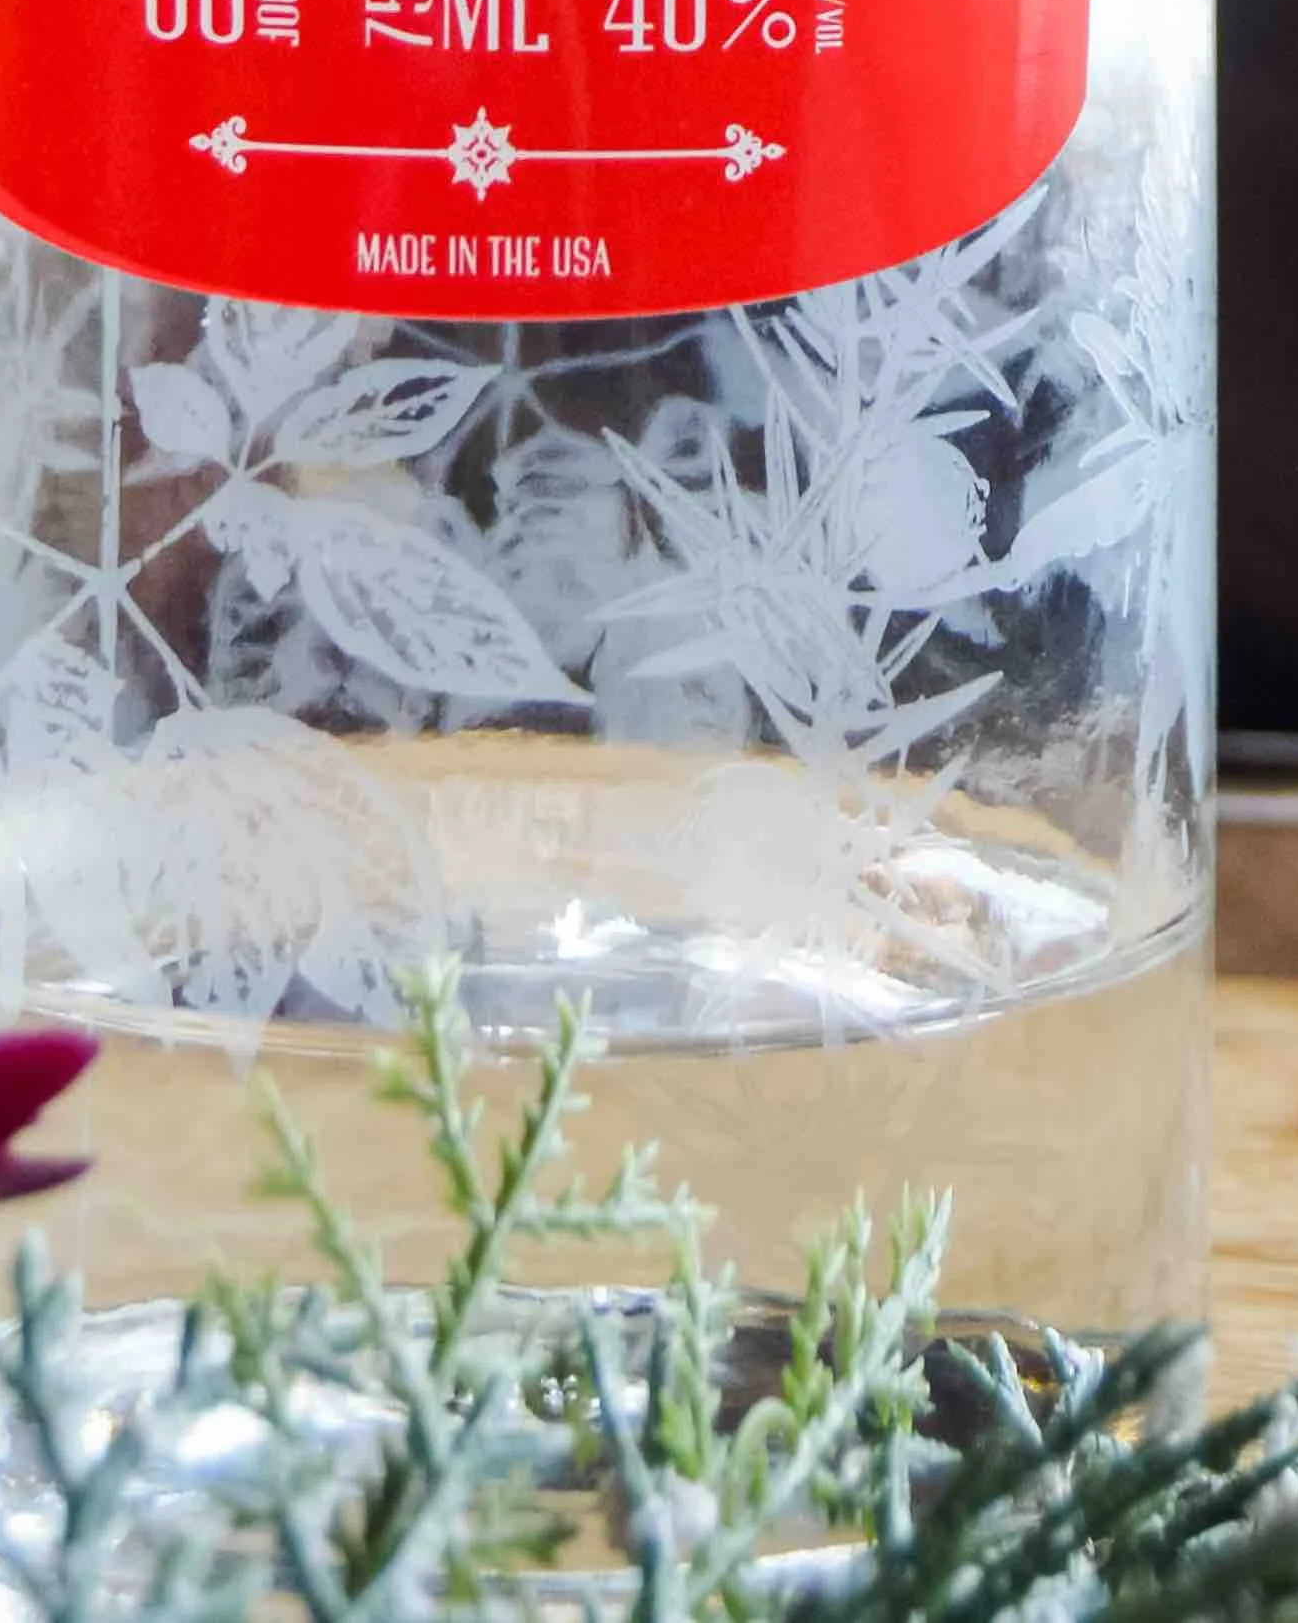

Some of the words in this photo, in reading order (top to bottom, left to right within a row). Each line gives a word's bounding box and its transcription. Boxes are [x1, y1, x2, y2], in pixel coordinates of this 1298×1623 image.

[356, 231, 437, 276] MADE
[448, 234, 478, 277] IN
[488, 235, 541, 277] THE
[552, 235, 612, 278] USA
